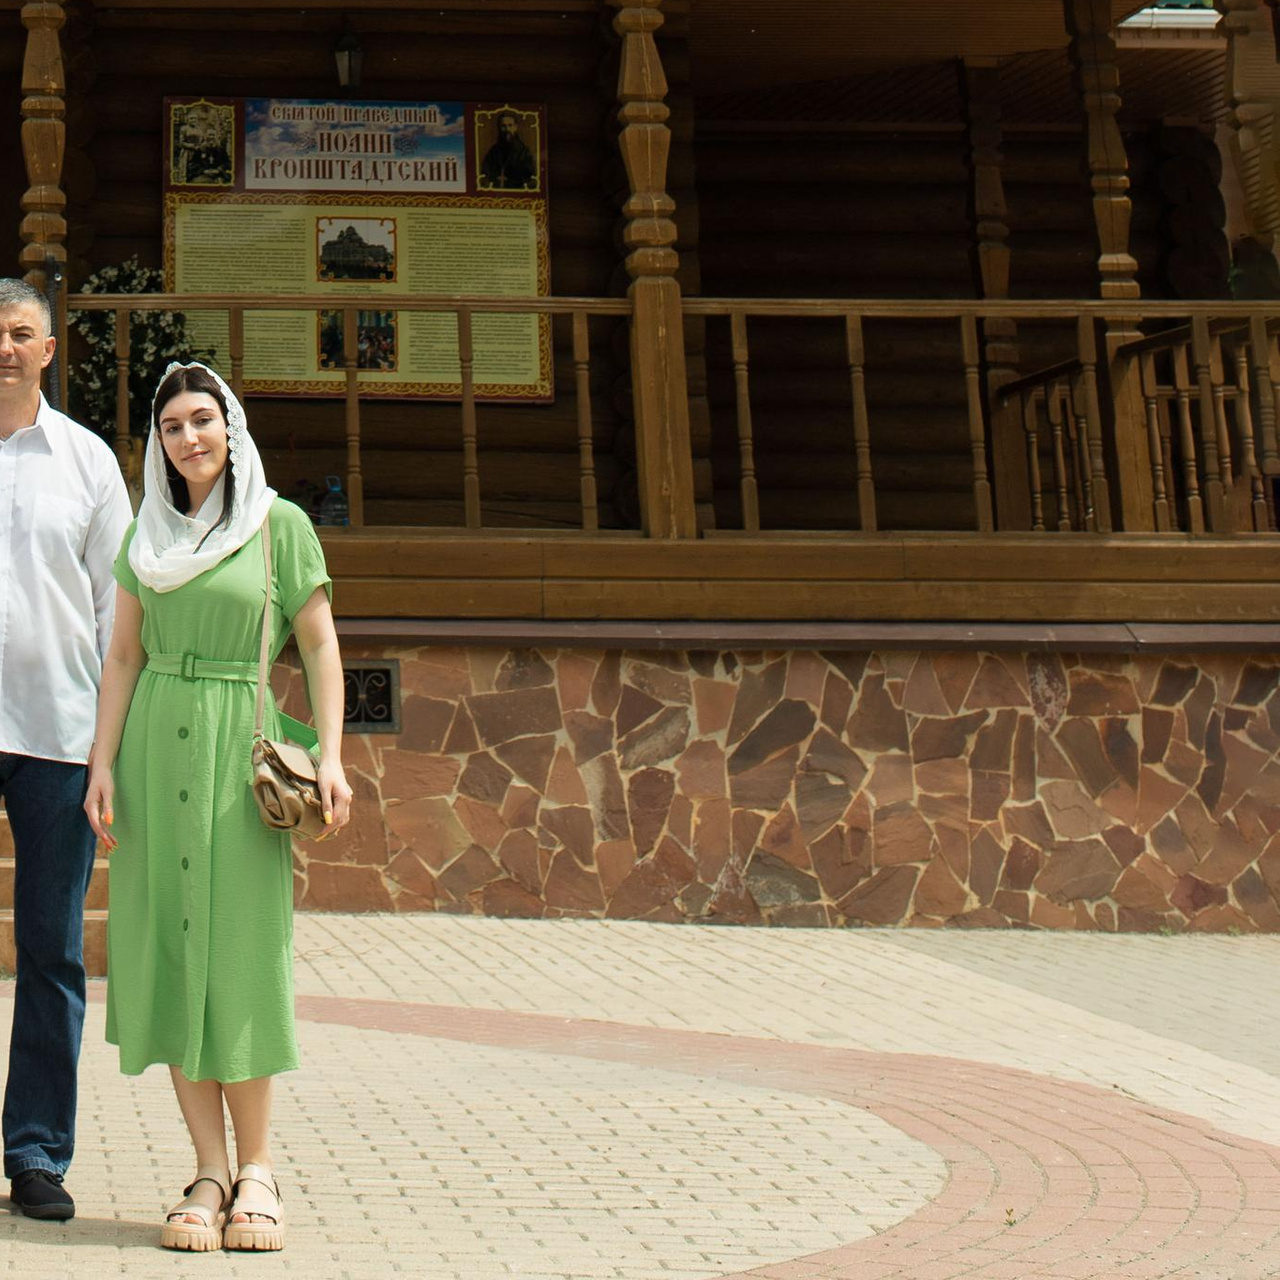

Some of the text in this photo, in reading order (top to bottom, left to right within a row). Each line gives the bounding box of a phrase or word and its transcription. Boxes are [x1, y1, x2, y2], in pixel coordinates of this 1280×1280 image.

[344, 106, 438, 125] ПРАВЕДНЫЙ
[319, 132, 392, 153] ИОАНН
[254, 158, 458, 185] КРОНШТАДТСКИЙ
